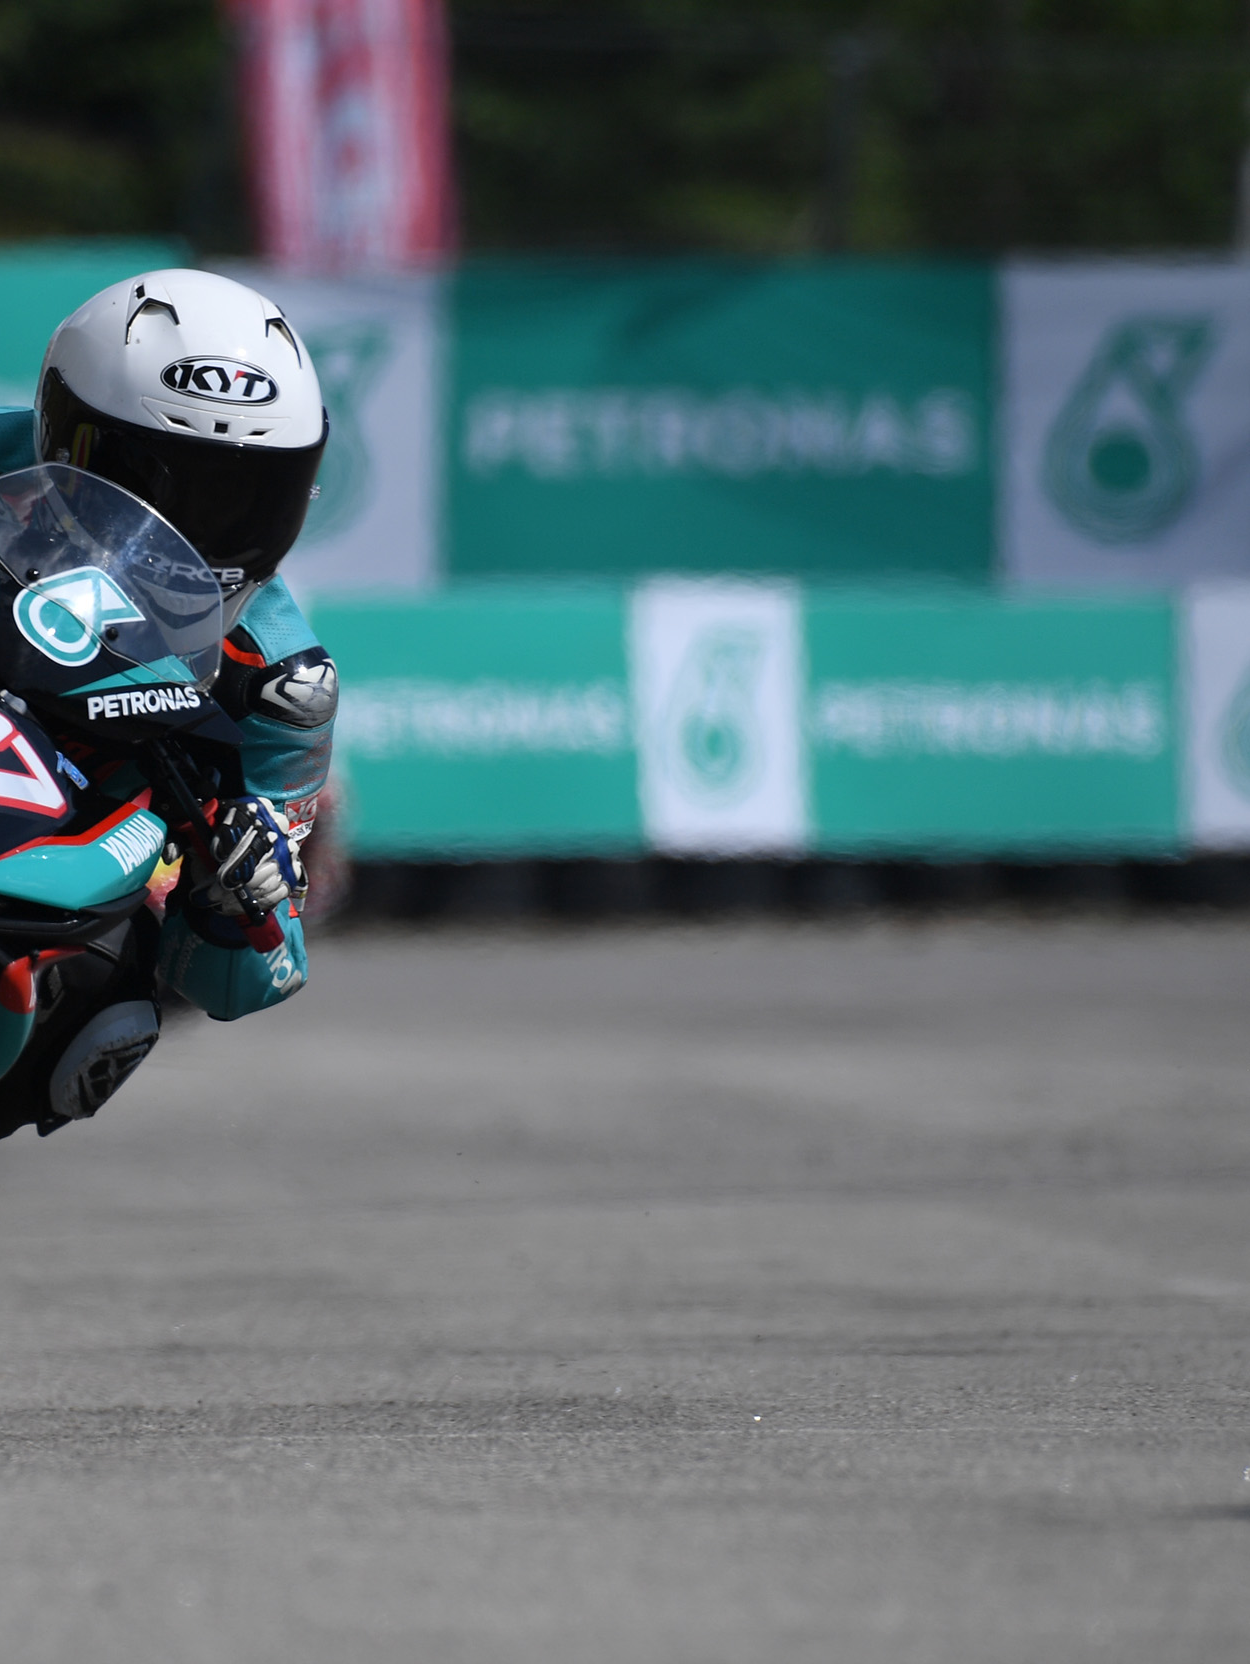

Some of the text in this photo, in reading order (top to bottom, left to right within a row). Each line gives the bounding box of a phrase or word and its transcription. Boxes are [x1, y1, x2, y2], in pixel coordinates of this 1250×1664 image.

[177, 363, 267, 398] KYT
[464, 389, 972, 476] PETRONAS
[87, 686, 201, 720] PETRONAS
[98, 814, 164, 876] YAMAHA
